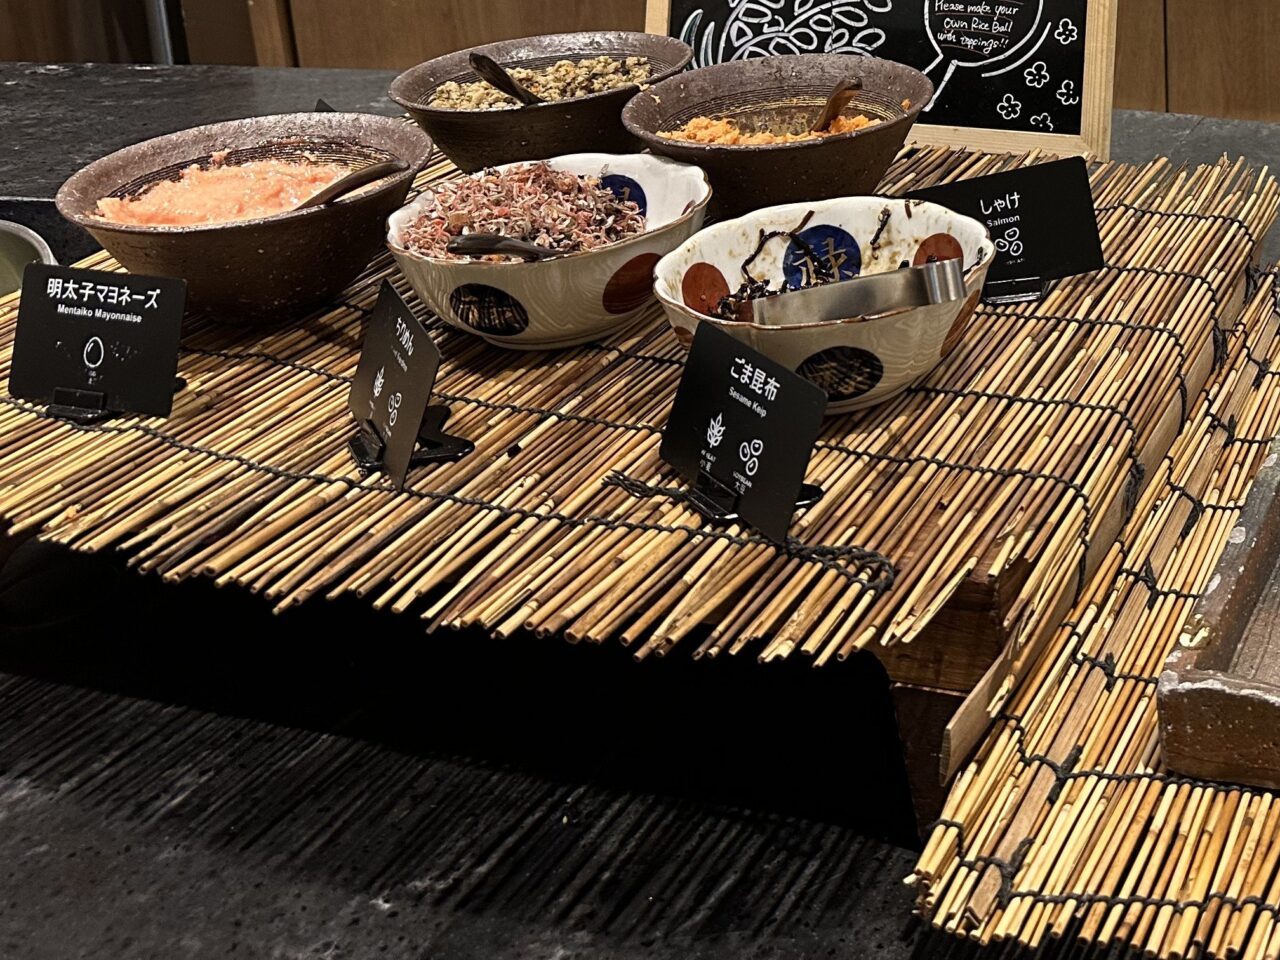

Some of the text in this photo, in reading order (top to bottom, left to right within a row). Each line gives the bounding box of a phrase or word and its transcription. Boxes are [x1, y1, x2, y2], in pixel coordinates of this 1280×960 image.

[967, 1, 991, 15] make
[995, 5, 1019, 20] your
[971, 16, 990, 31] Rice
[991, 21, 1013, 33] Ball
[937, 29, 956, 42] with
[980, 191, 1021, 215] しゃけ
[986, 214, 1020, 228] Salmon
[47, 278, 161, 309] 明太子マヨネーズ
[57, 303, 142, 323] Mentaiko Mayonnaise
[730, 357, 781, 401] ごま昆布
[729, 386, 752, 408] Sesame
